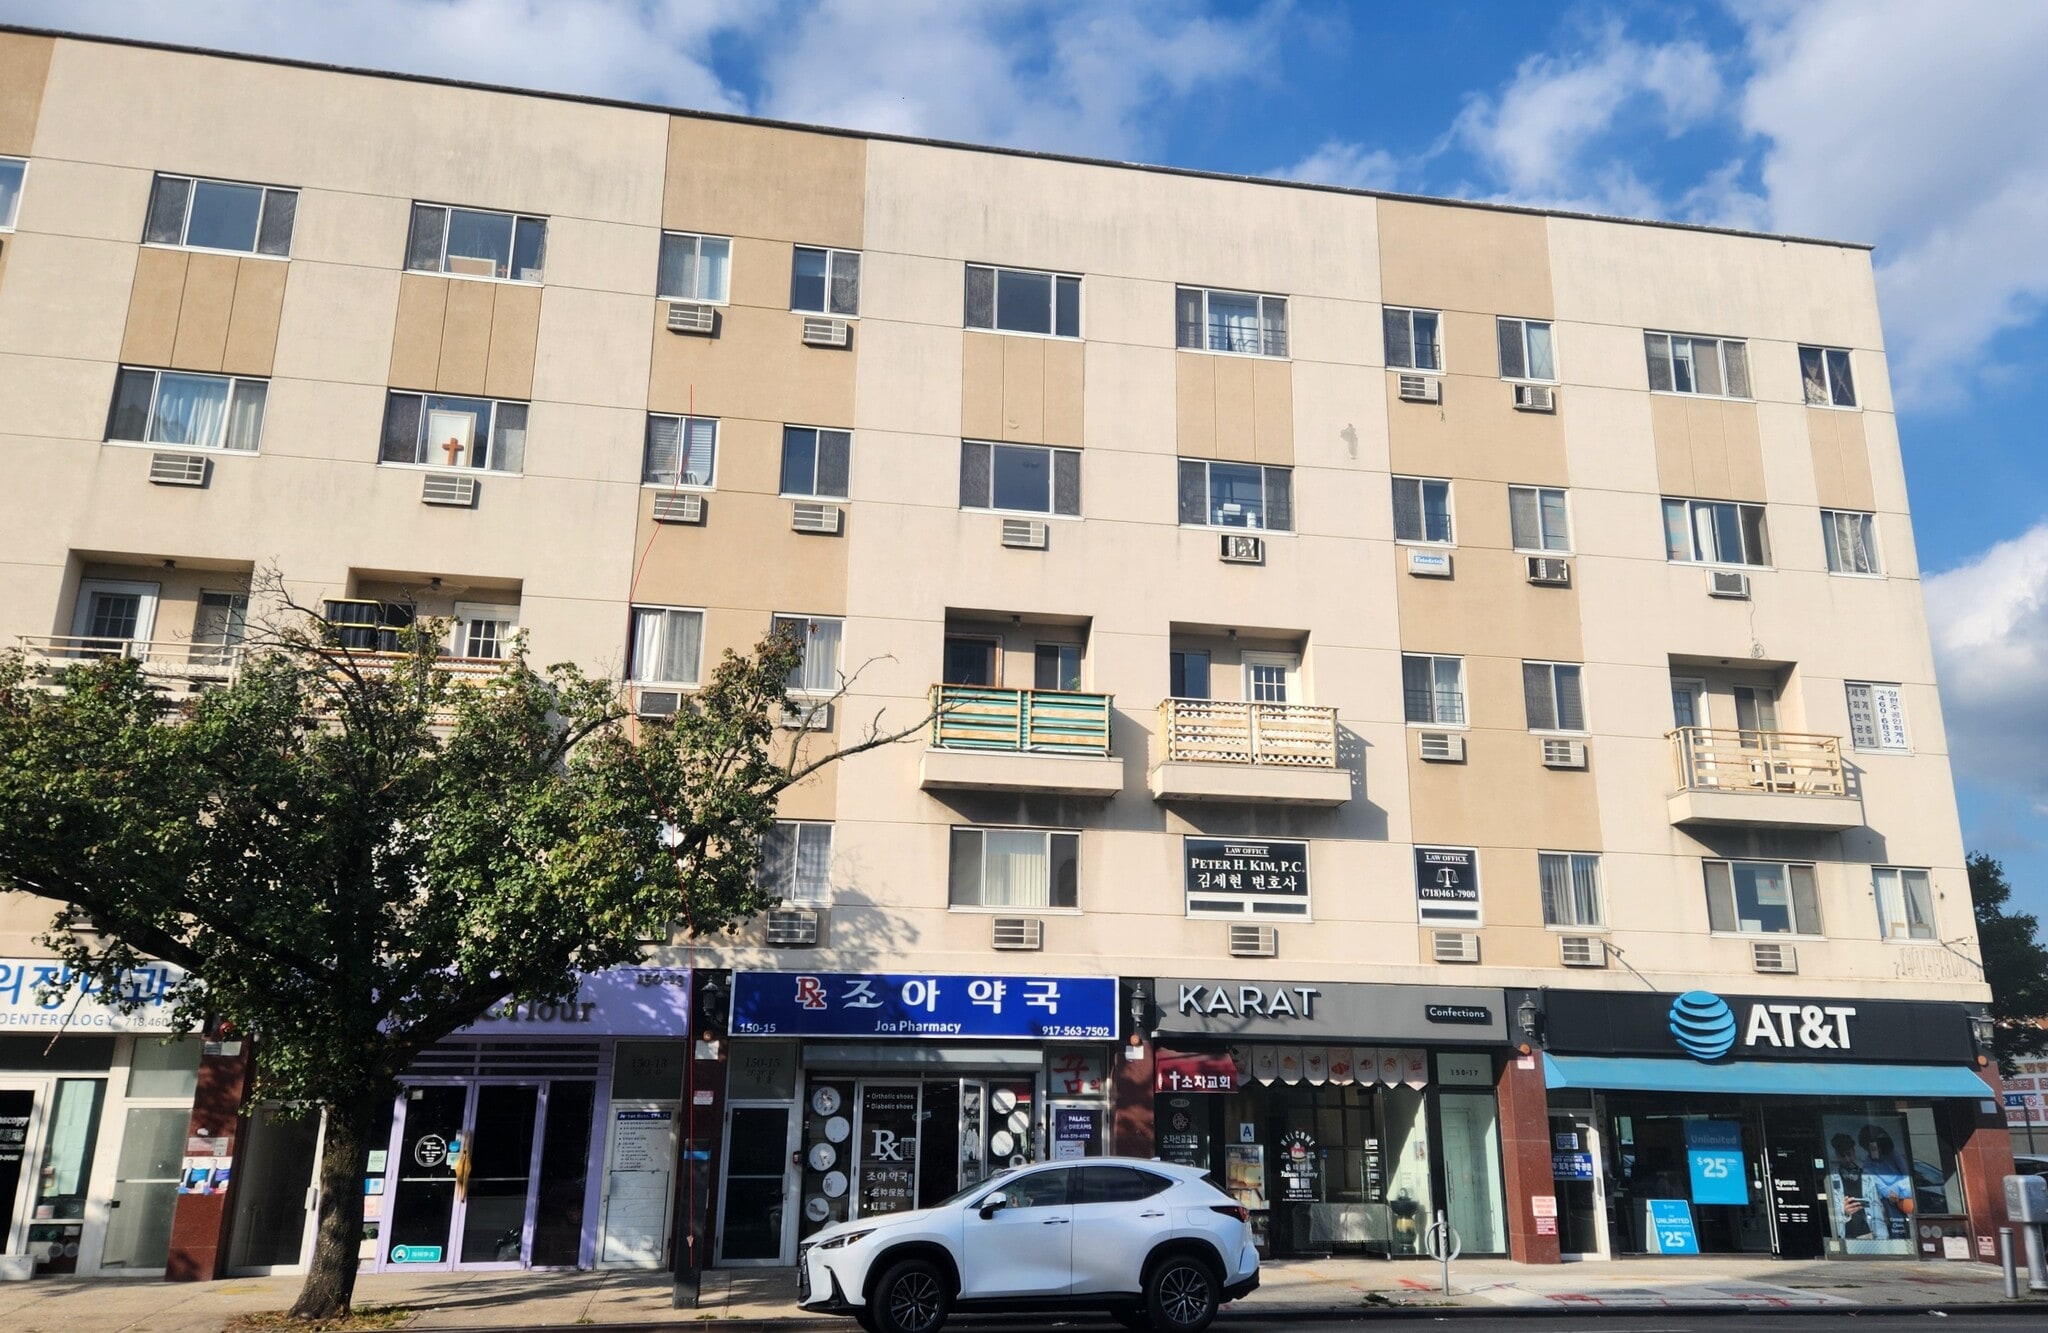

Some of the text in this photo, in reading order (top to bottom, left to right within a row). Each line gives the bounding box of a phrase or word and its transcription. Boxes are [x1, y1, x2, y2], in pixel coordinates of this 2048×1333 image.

[1192, 858, 1306, 873] PETER H. KIM, P.C.
[1197, 872, 1298, 892] 김세현 변호사
[1178, 984, 1318, 1016] KARAT
[1429, 1007, 1485, 1018] Confections
[740, 1023, 777, 1033] 150-15
[874, 1020, 961, 1034] Joa Pharmacy
[1042, 1026, 1110, 1037] 917-563-7502
[1744, 1004, 1857, 1050] AT&T
[1181, 1074, 1231, 1089] 소자교회
[871, 1092, 895, 1100] Orthotic
[1242, 1125, 1252, 1137] A
[1280, 1130, 1316, 1147] WELCOME
[1691, 1135, 1737, 1145] Unlimited
[1696, 1156, 1728, 1178] $25
[1656, 1217, 1690, 1225] UNLIMITED
